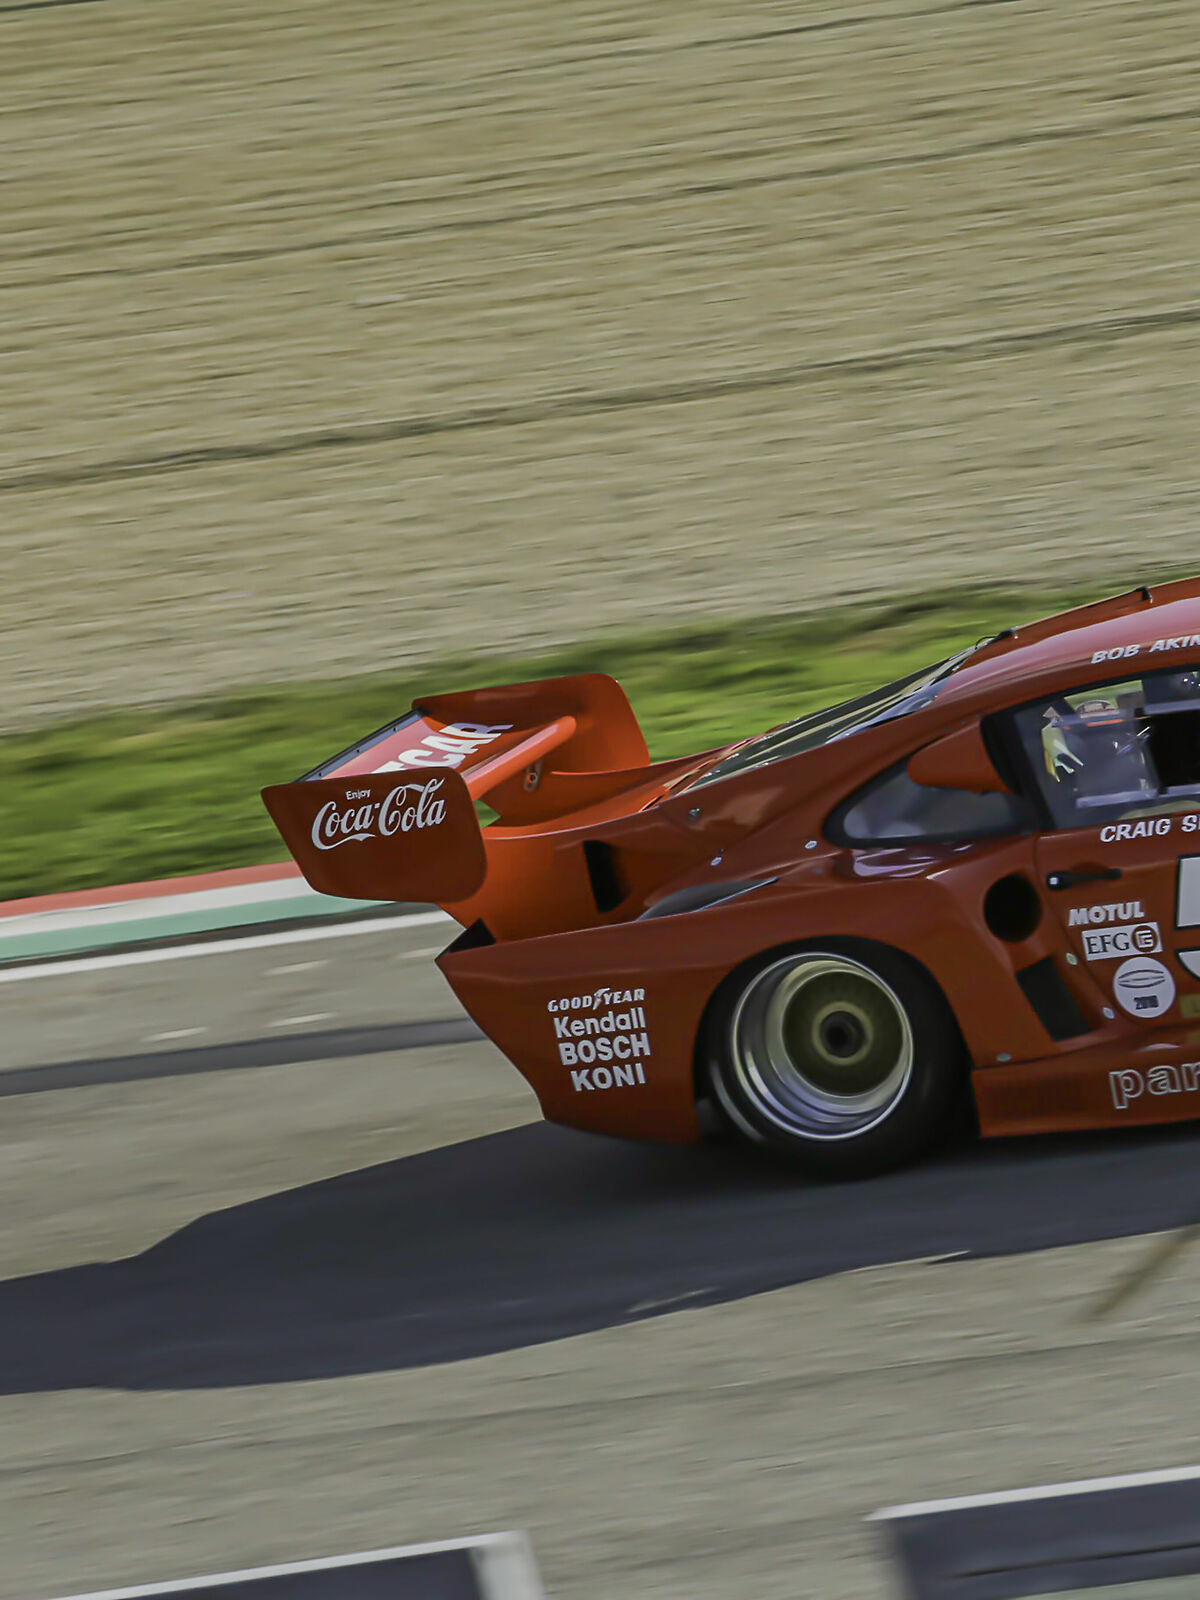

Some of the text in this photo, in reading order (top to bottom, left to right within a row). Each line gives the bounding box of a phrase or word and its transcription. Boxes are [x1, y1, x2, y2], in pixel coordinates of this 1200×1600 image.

[1091, 644, 1141, 664] BOB
[345, 789, 371, 801] Enjoy
[311, 777, 447, 850] Coca-Cola
[1100, 818, 1171, 843] CRAIG
[1068, 901, 1145, 926] MOTUL
[1085, 932, 1130, 955] EFG
[547, 987, 646, 1012] GOODYEAR
[553, 1006, 646, 1039] Kendall
[558, 1032, 651, 1066] BOSCH
[570, 1063, 646, 1092] KONI
